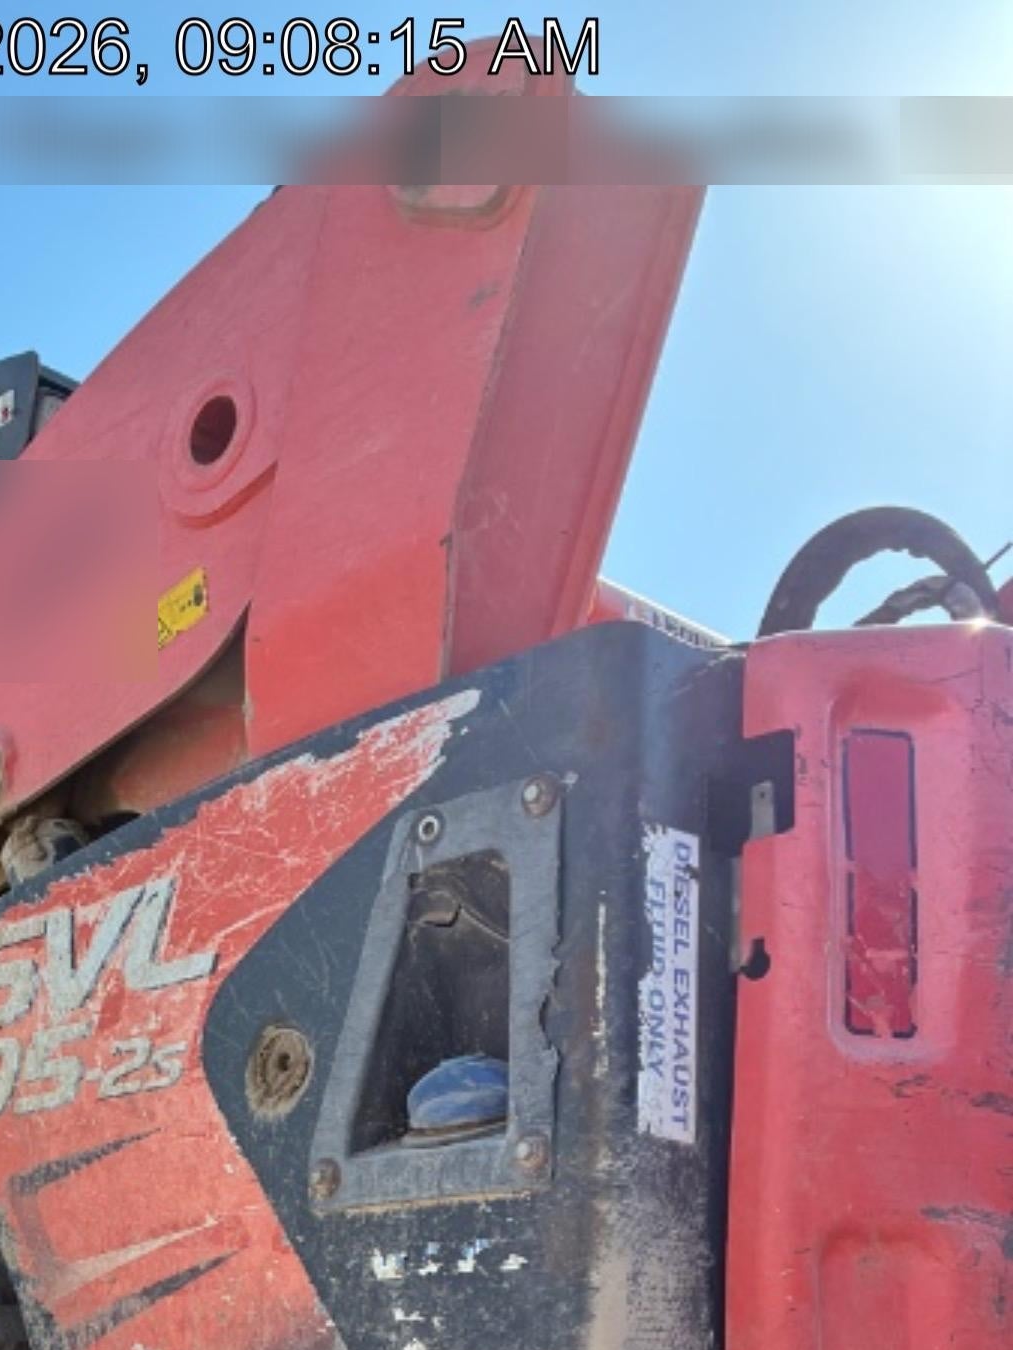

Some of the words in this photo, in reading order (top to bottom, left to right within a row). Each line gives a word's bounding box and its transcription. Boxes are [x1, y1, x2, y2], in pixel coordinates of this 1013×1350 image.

[673, 841, 691, 955] DIESEL
[648, 981, 666, 1077] ONLY
[671, 968, 690, 1132] EXHAUST
